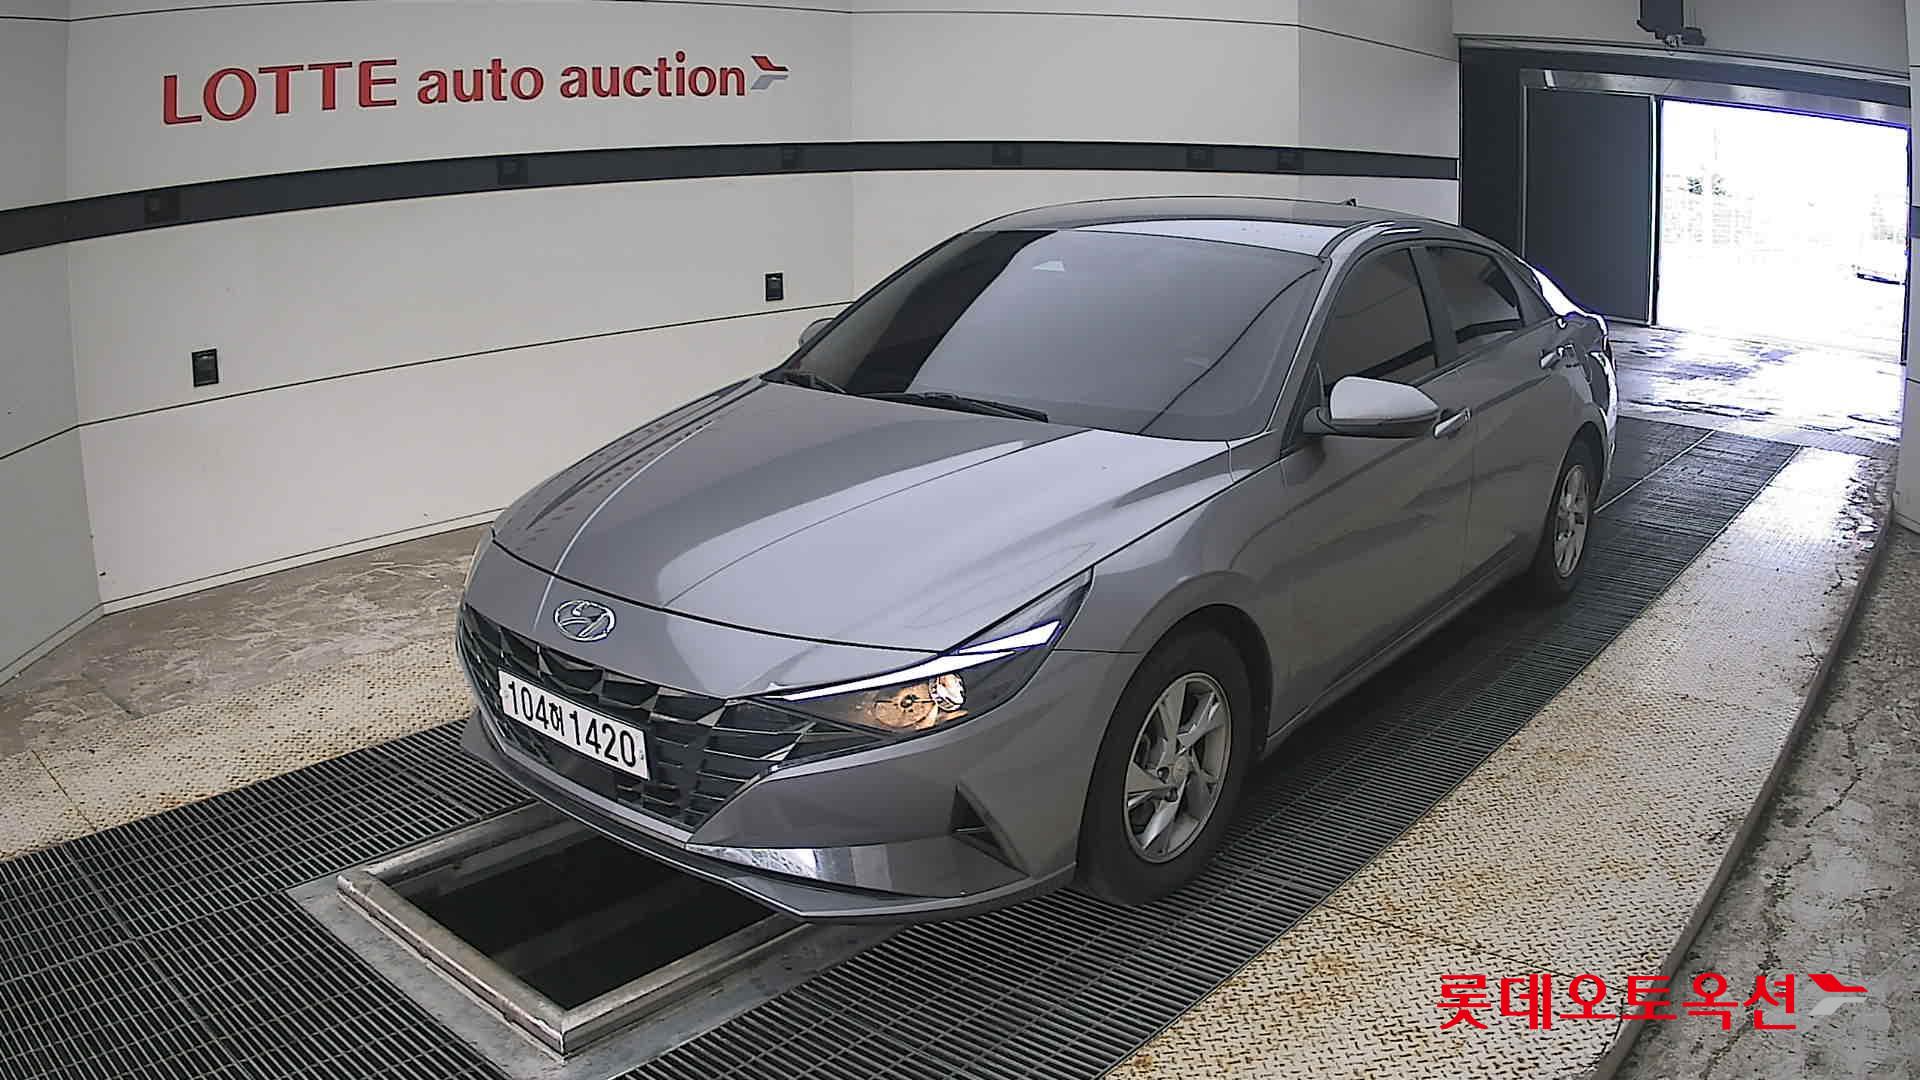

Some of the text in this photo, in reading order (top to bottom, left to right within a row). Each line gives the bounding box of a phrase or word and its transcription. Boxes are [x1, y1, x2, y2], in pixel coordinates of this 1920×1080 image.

[163, 51, 745, 124] LOTTE auto auction
